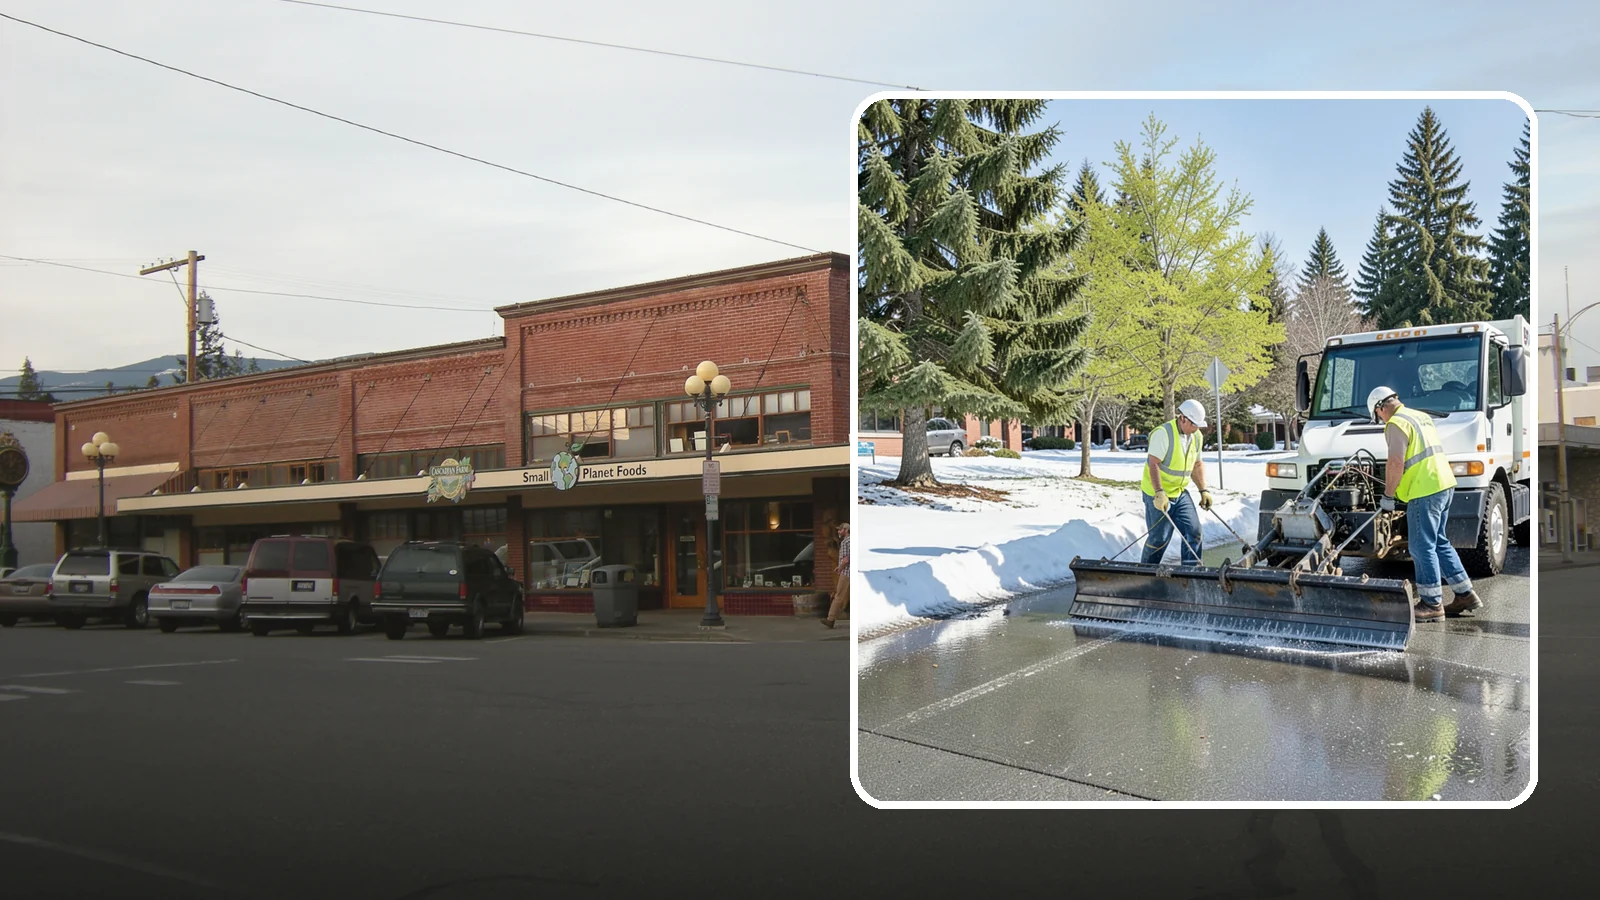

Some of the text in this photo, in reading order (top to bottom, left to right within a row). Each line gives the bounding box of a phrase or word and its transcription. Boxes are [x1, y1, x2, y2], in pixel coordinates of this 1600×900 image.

[523, 464, 647, 482] Small Planet Foods
